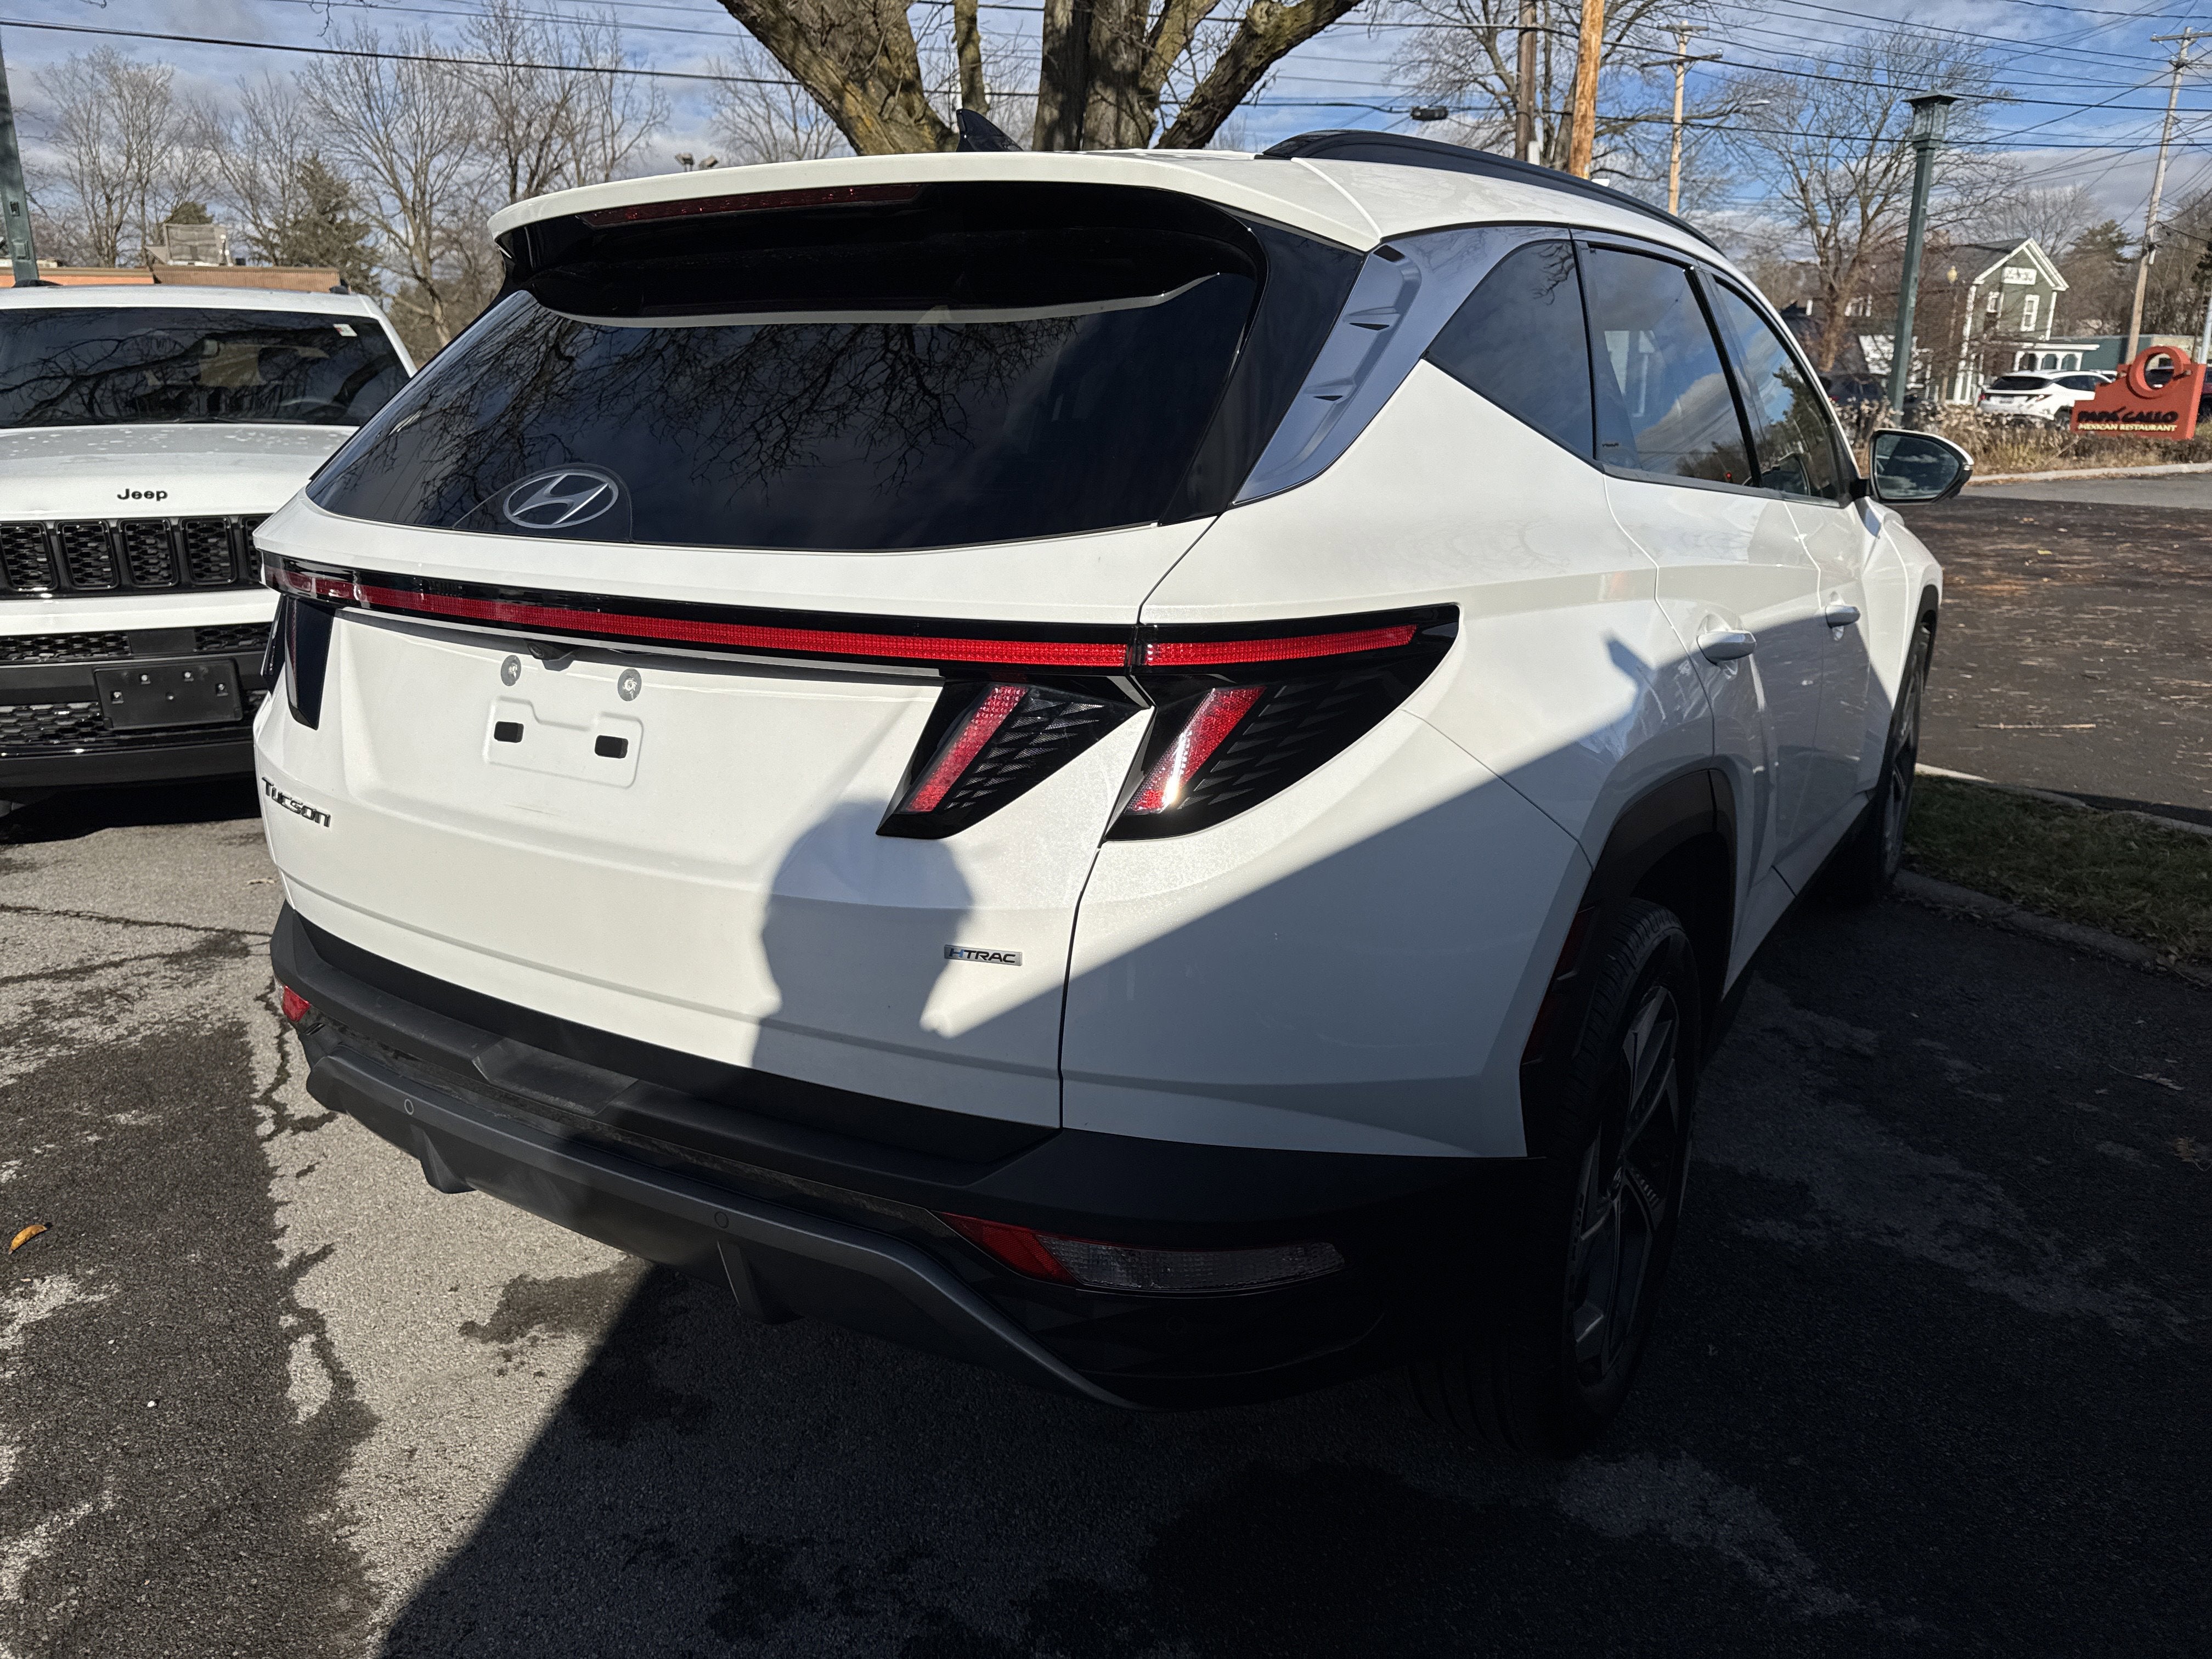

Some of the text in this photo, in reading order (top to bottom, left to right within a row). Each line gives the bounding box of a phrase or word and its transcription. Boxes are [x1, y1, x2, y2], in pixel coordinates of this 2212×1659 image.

[2078, 422, 2177, 432] MEXICAN RESTAURANT
[117, 488, 168, 501] Jeep
[949, 948, 1016, 963] HTRAC
